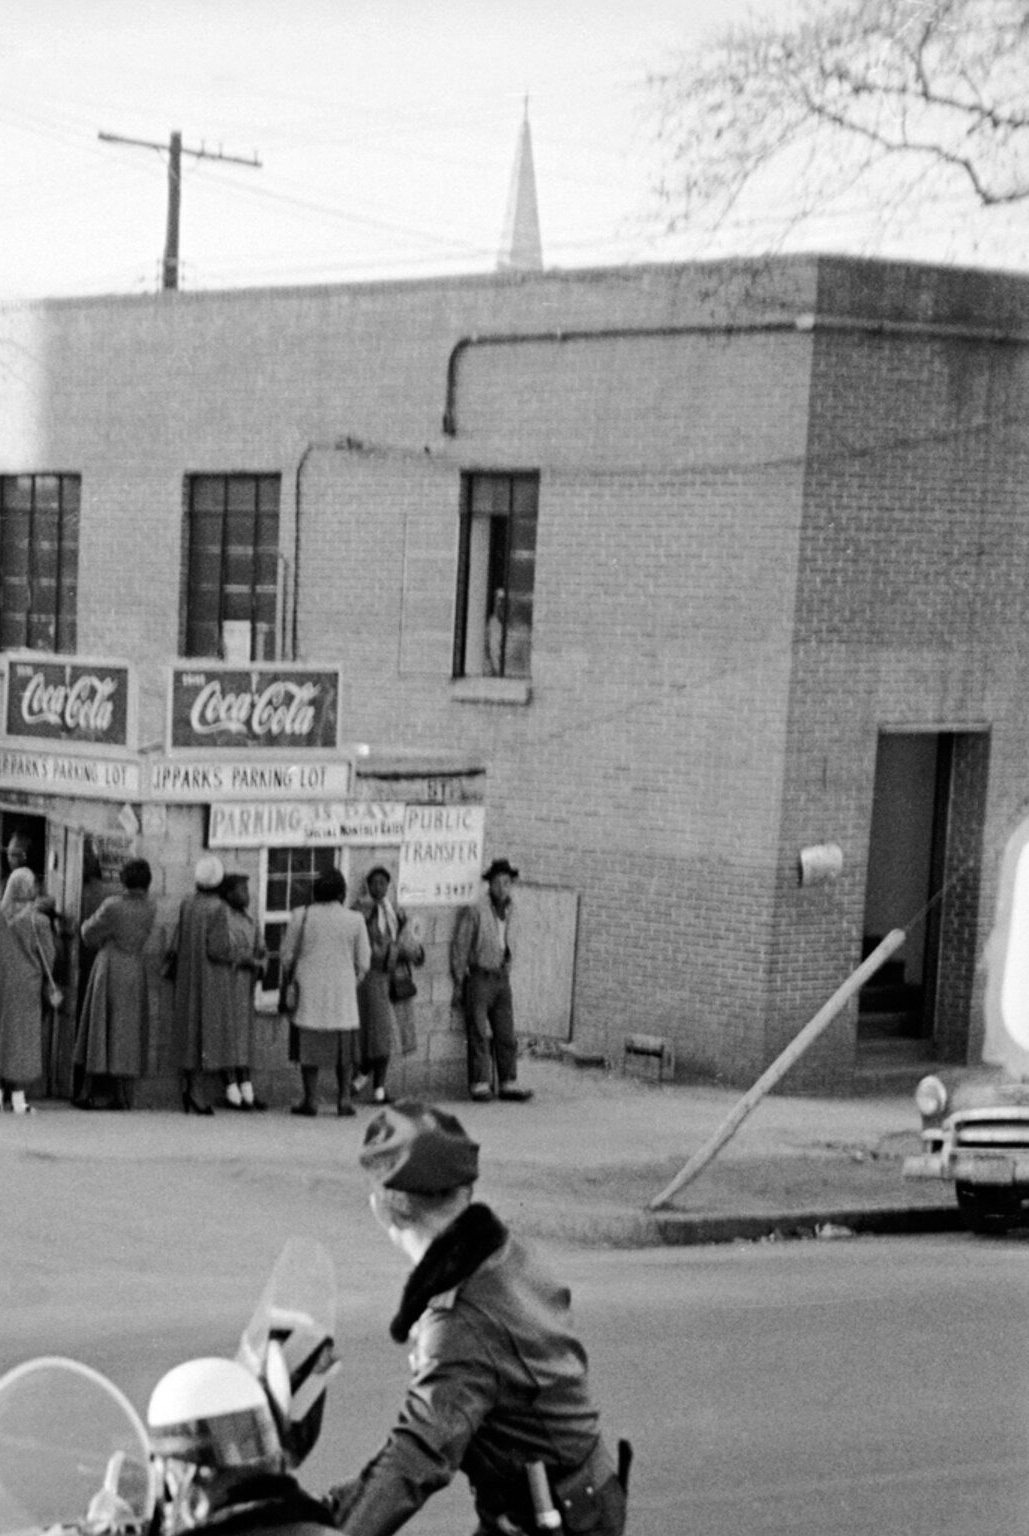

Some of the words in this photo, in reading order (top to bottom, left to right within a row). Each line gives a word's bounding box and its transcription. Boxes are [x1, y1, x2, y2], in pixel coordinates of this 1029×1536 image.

[190, 680, 322, 735] Coca-Cola
[52, 757, 98, 782] PARKING
[105, 764, 126, 786] LOT
[232, 766, 292, 788] PARKING
[300, 766, 326, 788] LOT
[211, 806, 301, 838] PARKING
[340, 823, 378, 836] MONTHLY
[408, 809, 471, 829] PUBLIC
[403, 841, 478, 862] TRANSFER
